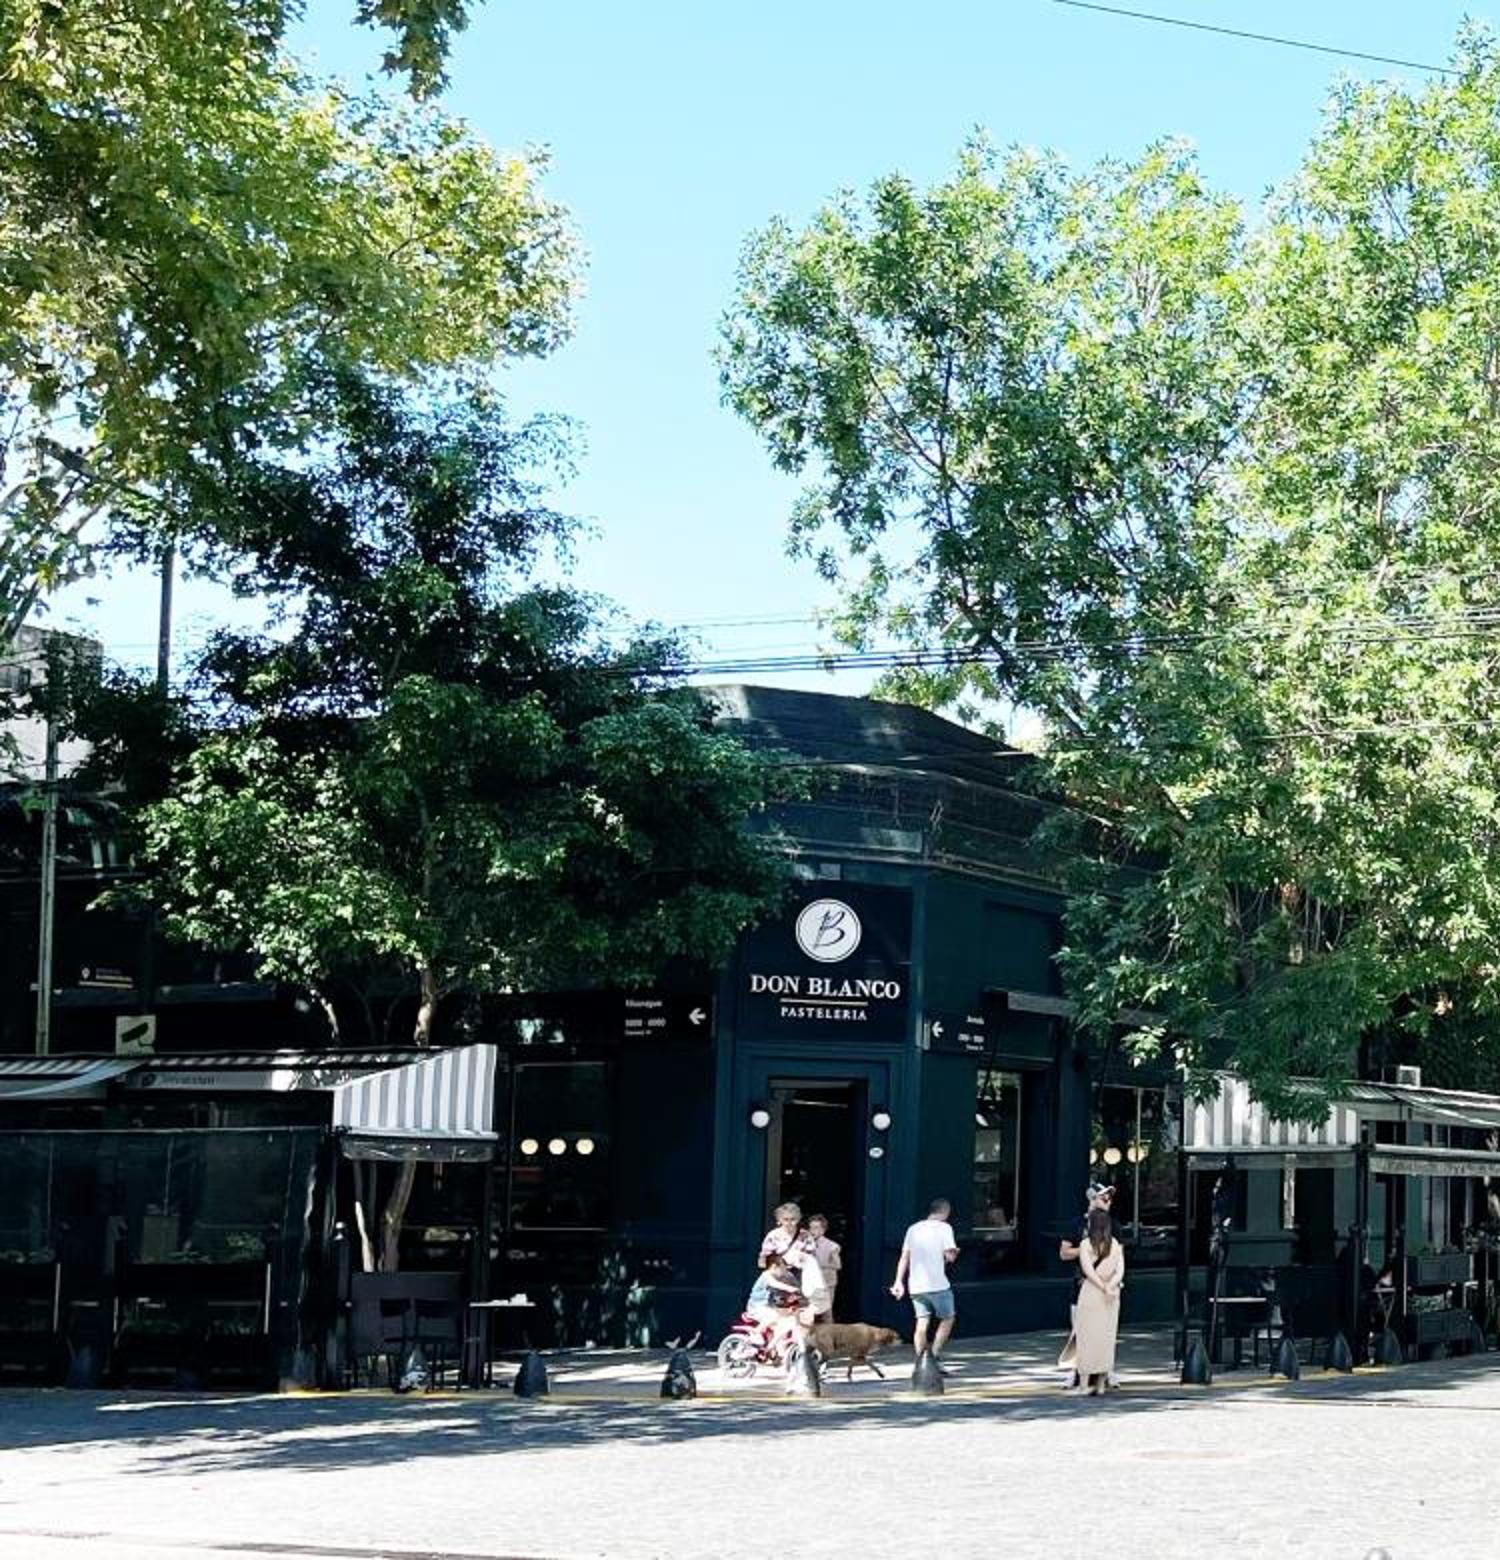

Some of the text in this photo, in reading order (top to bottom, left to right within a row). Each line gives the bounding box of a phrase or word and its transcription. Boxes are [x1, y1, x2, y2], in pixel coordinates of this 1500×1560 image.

[750, 974, 901, 1000] DON BLANCO
[780, 1006, 868, 1021] PASTELERIA
